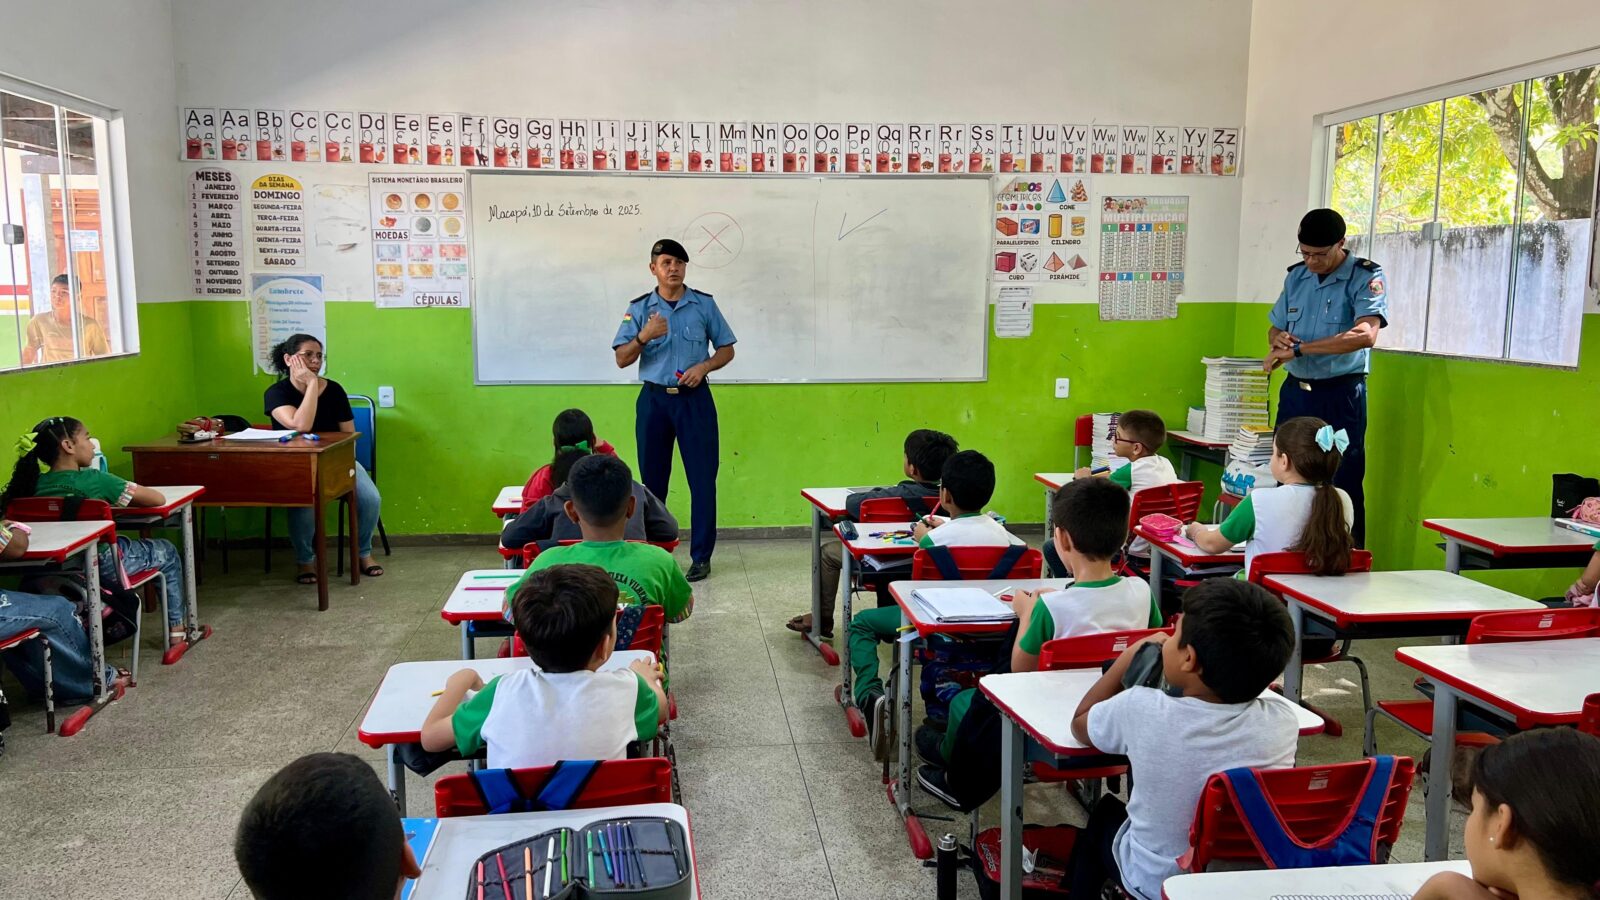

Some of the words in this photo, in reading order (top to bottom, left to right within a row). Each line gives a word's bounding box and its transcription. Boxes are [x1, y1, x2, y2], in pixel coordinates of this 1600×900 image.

[196, 172, 231, 181] MESES
[254, 191, 300, 199] DOMINGO
[544, 203, 553, 217] de
[558, 202, 598, 217] Setembro
[603, 204, 612, 215] de
[415, 293, 459, 305] CÉDULAS
